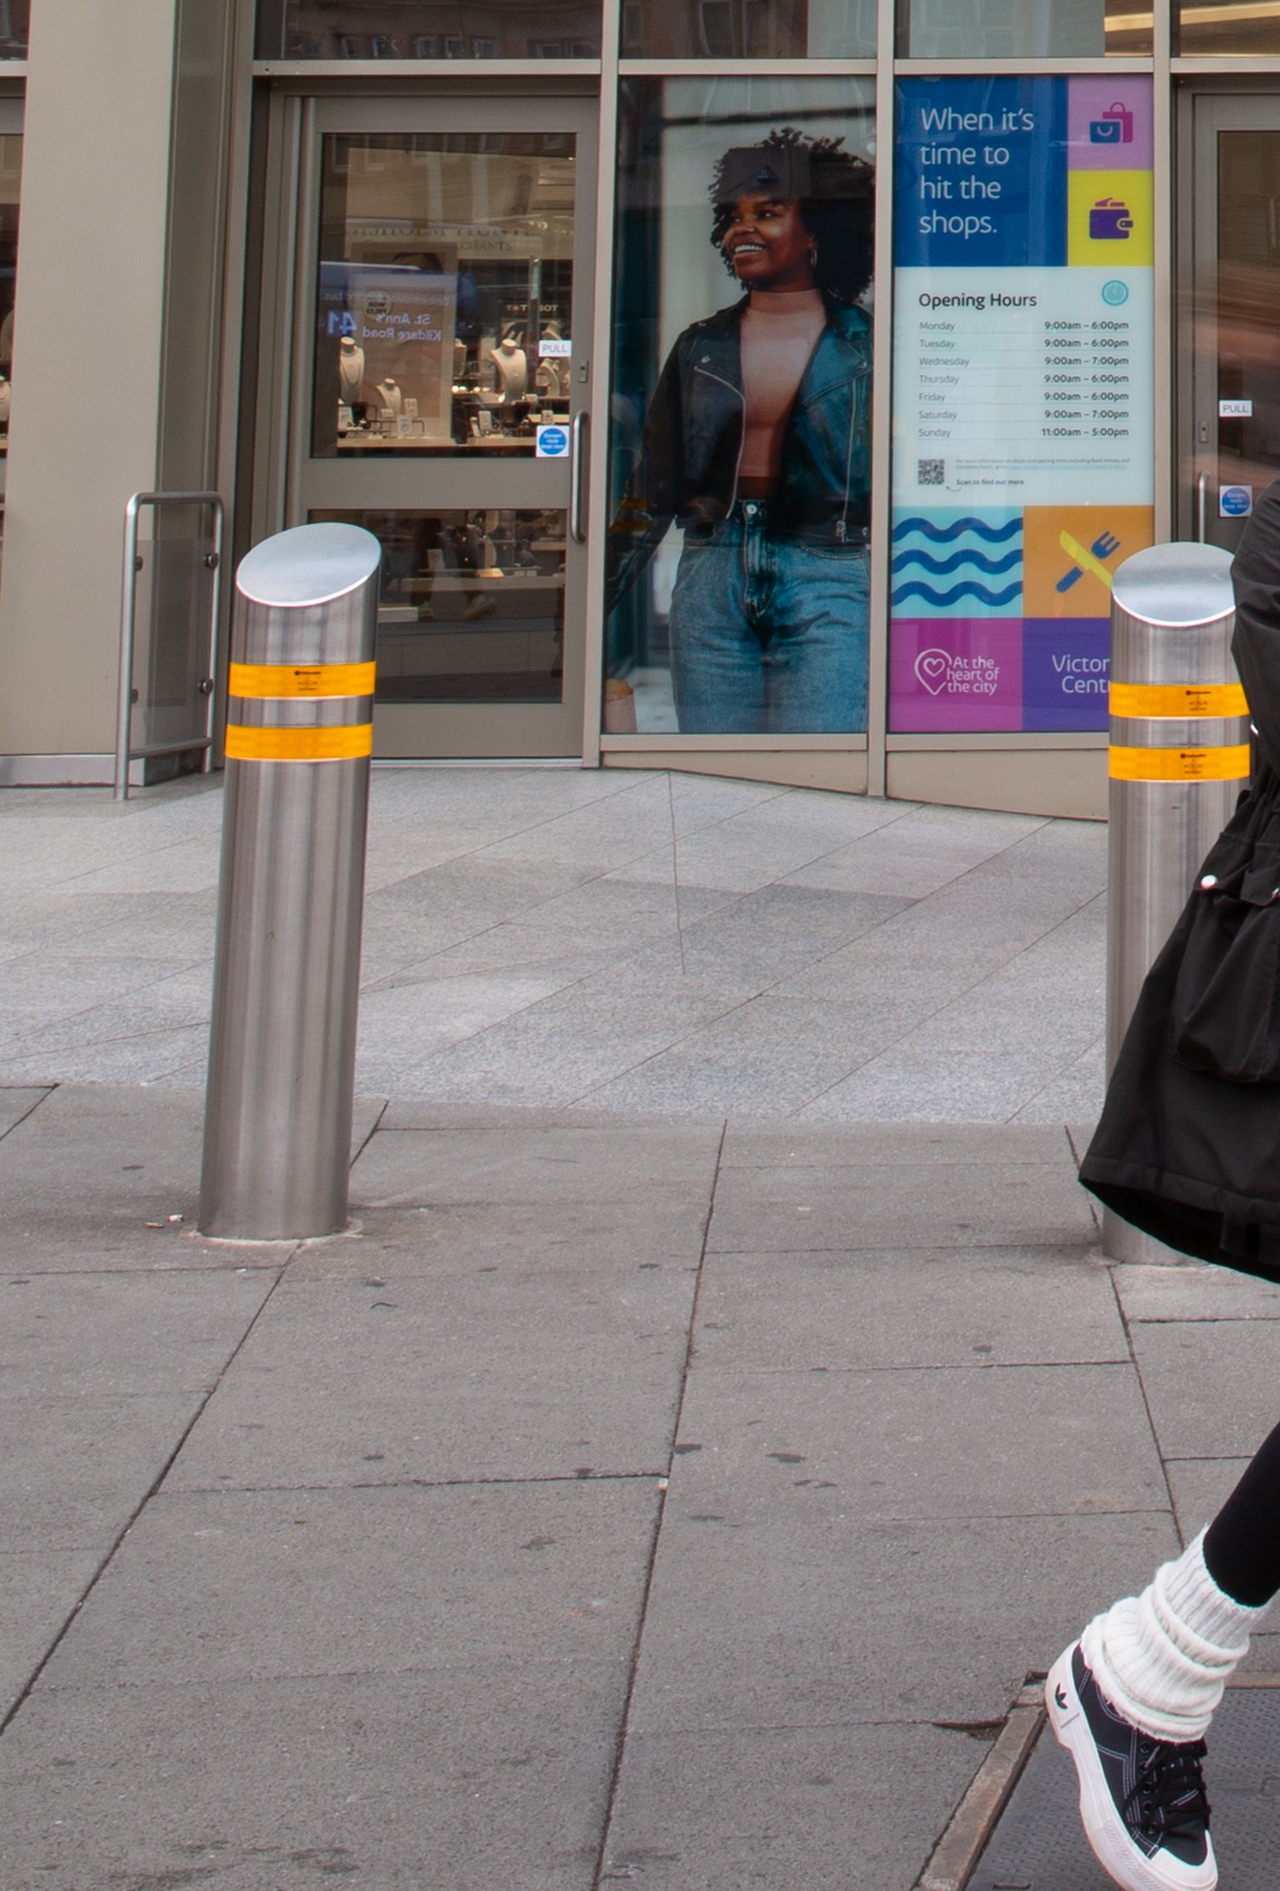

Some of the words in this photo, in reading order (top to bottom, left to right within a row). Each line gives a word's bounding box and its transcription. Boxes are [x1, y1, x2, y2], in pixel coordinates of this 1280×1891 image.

[920, 106, 994, 131] When
[1001, 107, 1035, 131] it's
[919, 141, 977, 166] time
[983, 144, 1010, 166] to
[919, 174, 953, 200] hit
[960, 174, 1002, 200] the
[918, 209, 998, 240] shops.
[918, 293, 986, 310] Opening
[989, 293, 1038, 307] Hours
[918, 321, 955, 331] Monday
[1044, 321, 1082, 330] 9:00am
[1091, 321, 1130, 331] 6:00pm
[542, 344, 568, 353] PULL
[918, 339, 955, 350] Tuesday
[1044, 339, 1082, 348] 9:00am
[1091, 339, 1130, 350] 6:00pm
[918, 357, 970, 367] Wednesday
[1044, 357, 1082, 366] 9:00am
[1091, 357, 1130, 367] 7:00pm
[918, 375, 960, 385] Thursday
[1044, 375, 1082, 384] 9:00am
[1091, 375, 1130, 385] 6:00pm
[918, 392, 946, 403] Friday
[1044, 392, 1082, 402] 9:00am
[1091, 392, 1130, 403] 6:00pm
[1222, 403, 1248, 414] PULL
[918, 410, 958, 421] Saturday
[1044, 410, 1082, 420] 9:00am
[1091, 410, 1130, 421] 7:00pm
[918, 428, 951, 438] Sunday
[1041, 428, 1082, 437] 11:00am
[1091, 428, 1130, 438] 5:00pm
[952, 657, 970, 669] At
[971, 656, 995, 669] the
[946, 667, 983, 681] heart
[984, 667, 1000, 681] of
[947, 681, 966, 694] the
[967, 682, 998, 696] city
